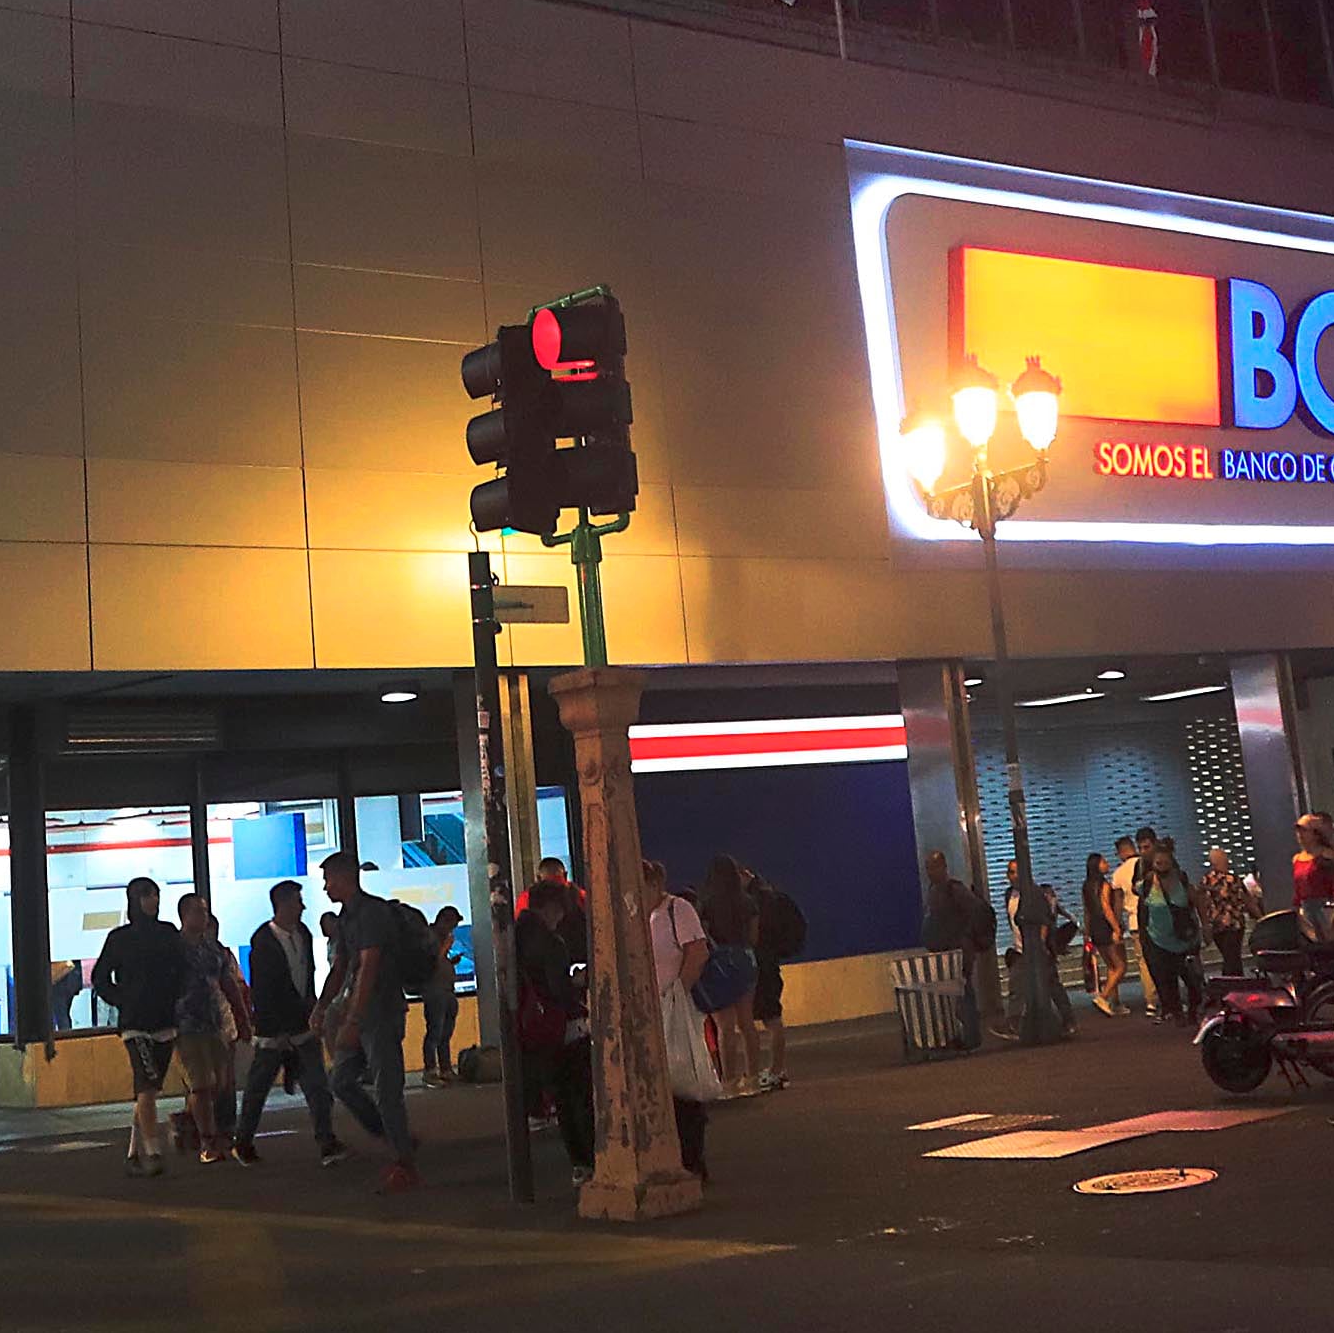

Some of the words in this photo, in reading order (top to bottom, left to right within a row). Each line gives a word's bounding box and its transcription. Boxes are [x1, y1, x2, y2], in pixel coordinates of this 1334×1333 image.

[1098, 442, 1185, 477] SOMOS
[1190, 447, 1214, 480] EL
[1223, 449, 1295, 482] BANCO
[1301, 454, 1327, 483] DE
